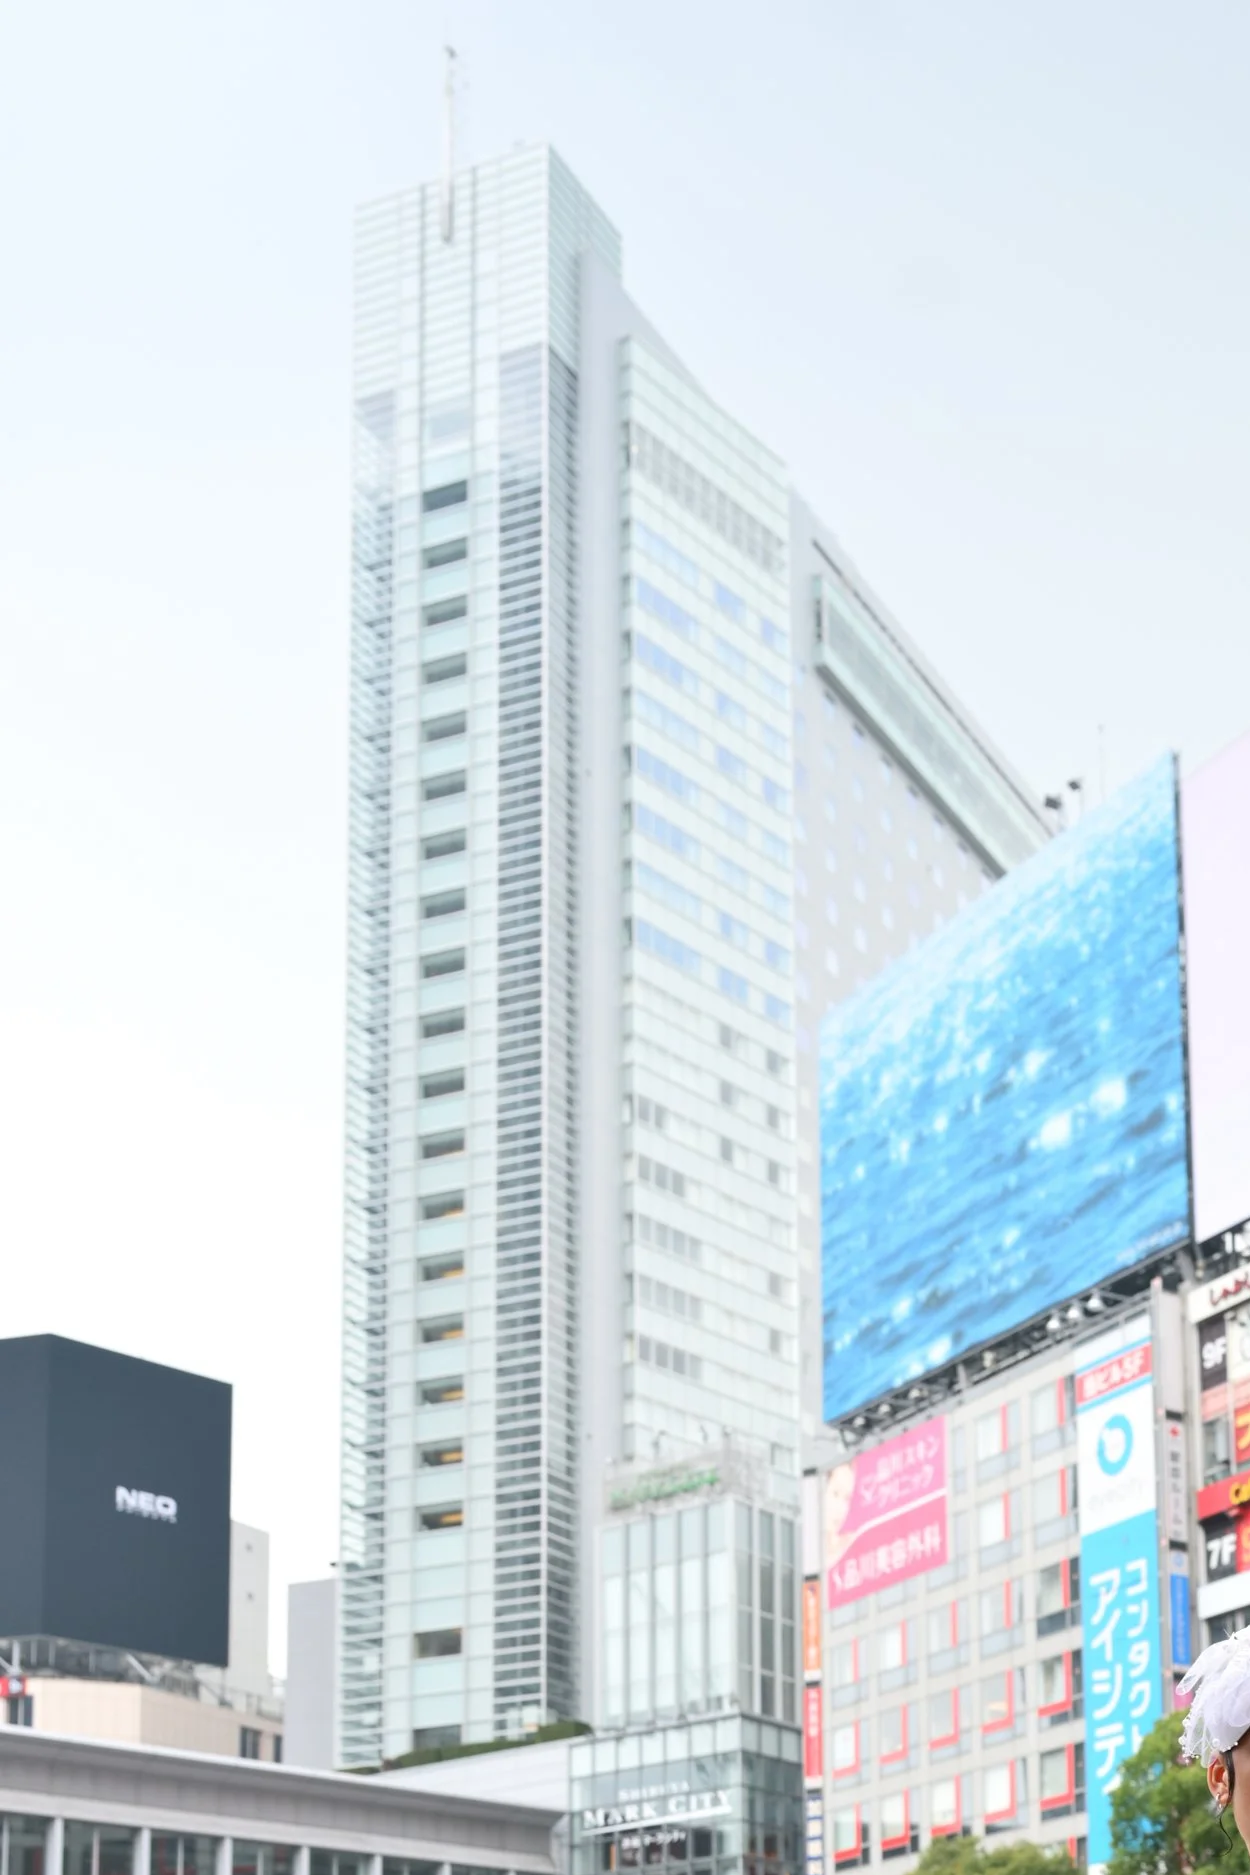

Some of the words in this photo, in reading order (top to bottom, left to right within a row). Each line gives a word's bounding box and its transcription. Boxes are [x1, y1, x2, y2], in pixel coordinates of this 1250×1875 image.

[1202, 1336, 1226, 1369] 9F
[116, 1485, 177, 1516] NEO
[1207, 1533, 1236, 1570] 7F
[1126, 1558, 1151, 1753] コンタクト
[583, 1803, 656, 1829] MARK
[668, 1790, 728, 1813] CITY
